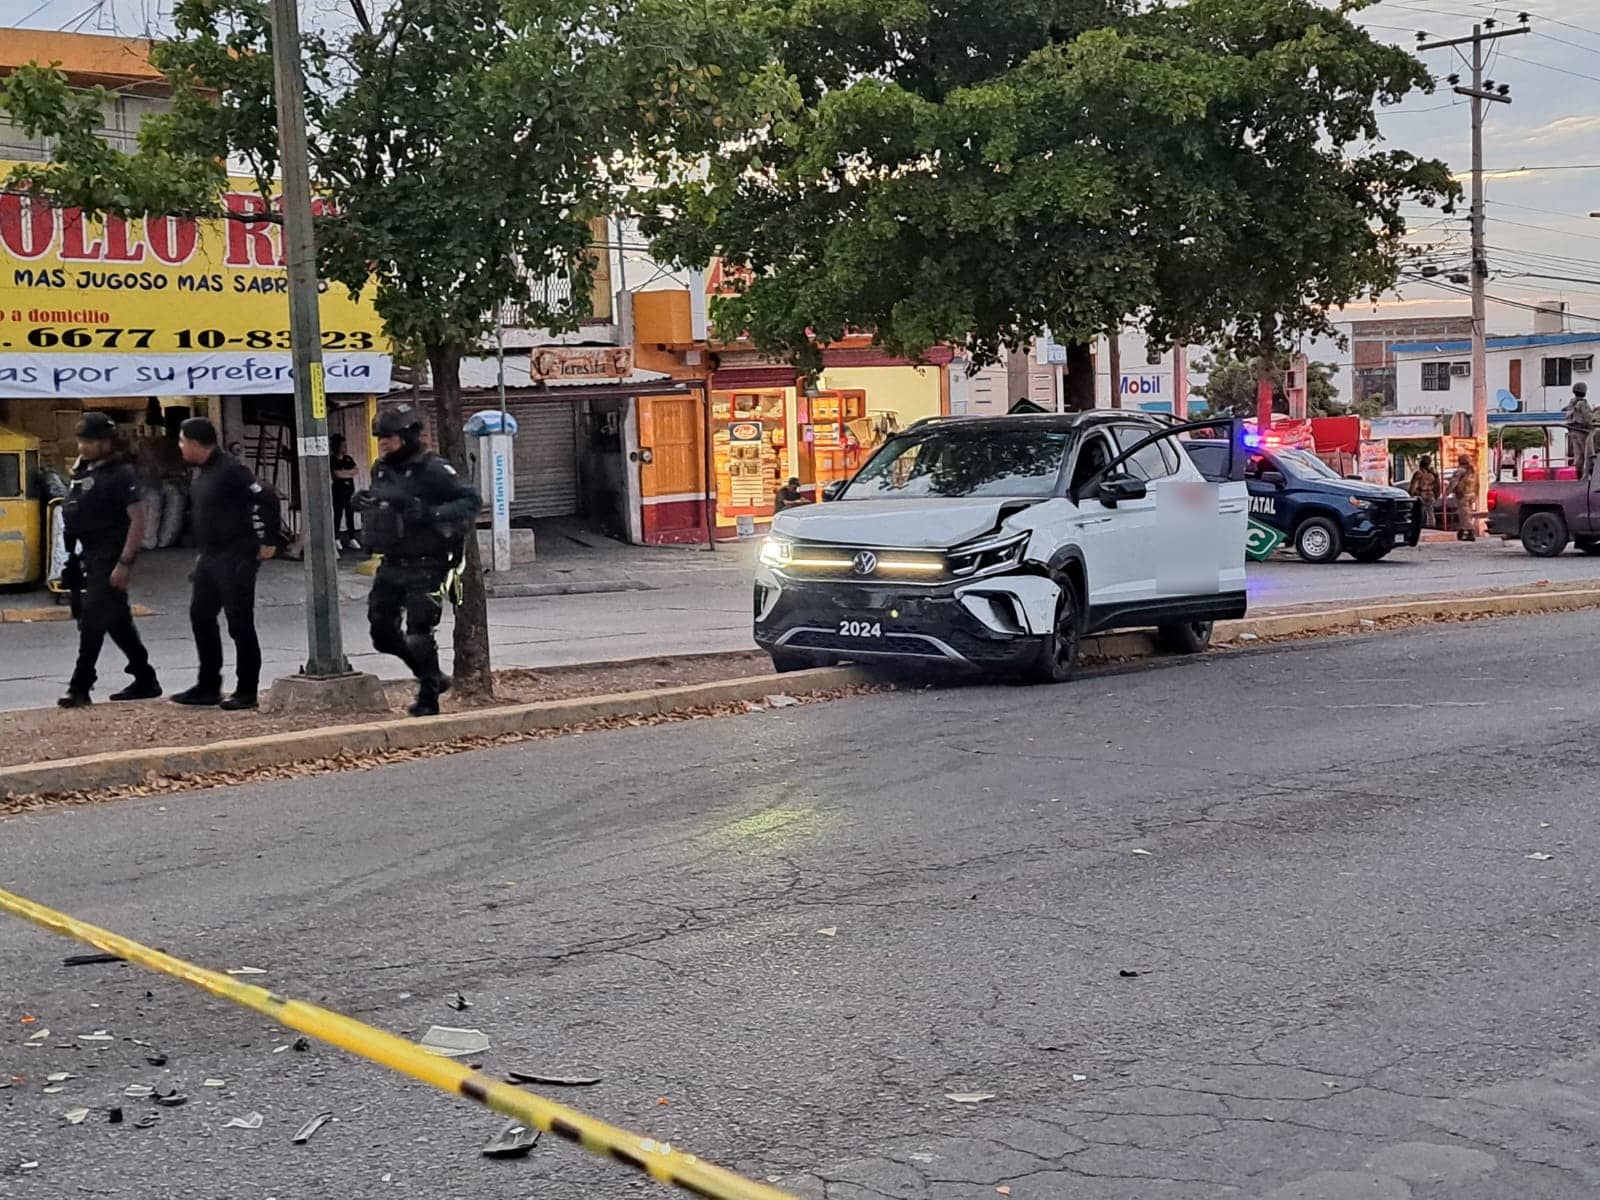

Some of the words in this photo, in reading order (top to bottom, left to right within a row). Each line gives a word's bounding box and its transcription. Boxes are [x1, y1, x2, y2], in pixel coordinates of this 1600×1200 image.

[14, 269, 66, 288] MAS
[76, 271, 168, 289] JUGOSO
[178, 274, 224, 292] MAS
[11, 310, 22, 321] a
[28, 309, 110, 323] domicilio
[27, 327, 156, 348] 6677
[53, 366, 120, 392] por
[136, 366, 176, 381] su
[1119, 375, 1160, 394] Mobil
[839, 620, 881, 638] 2024
